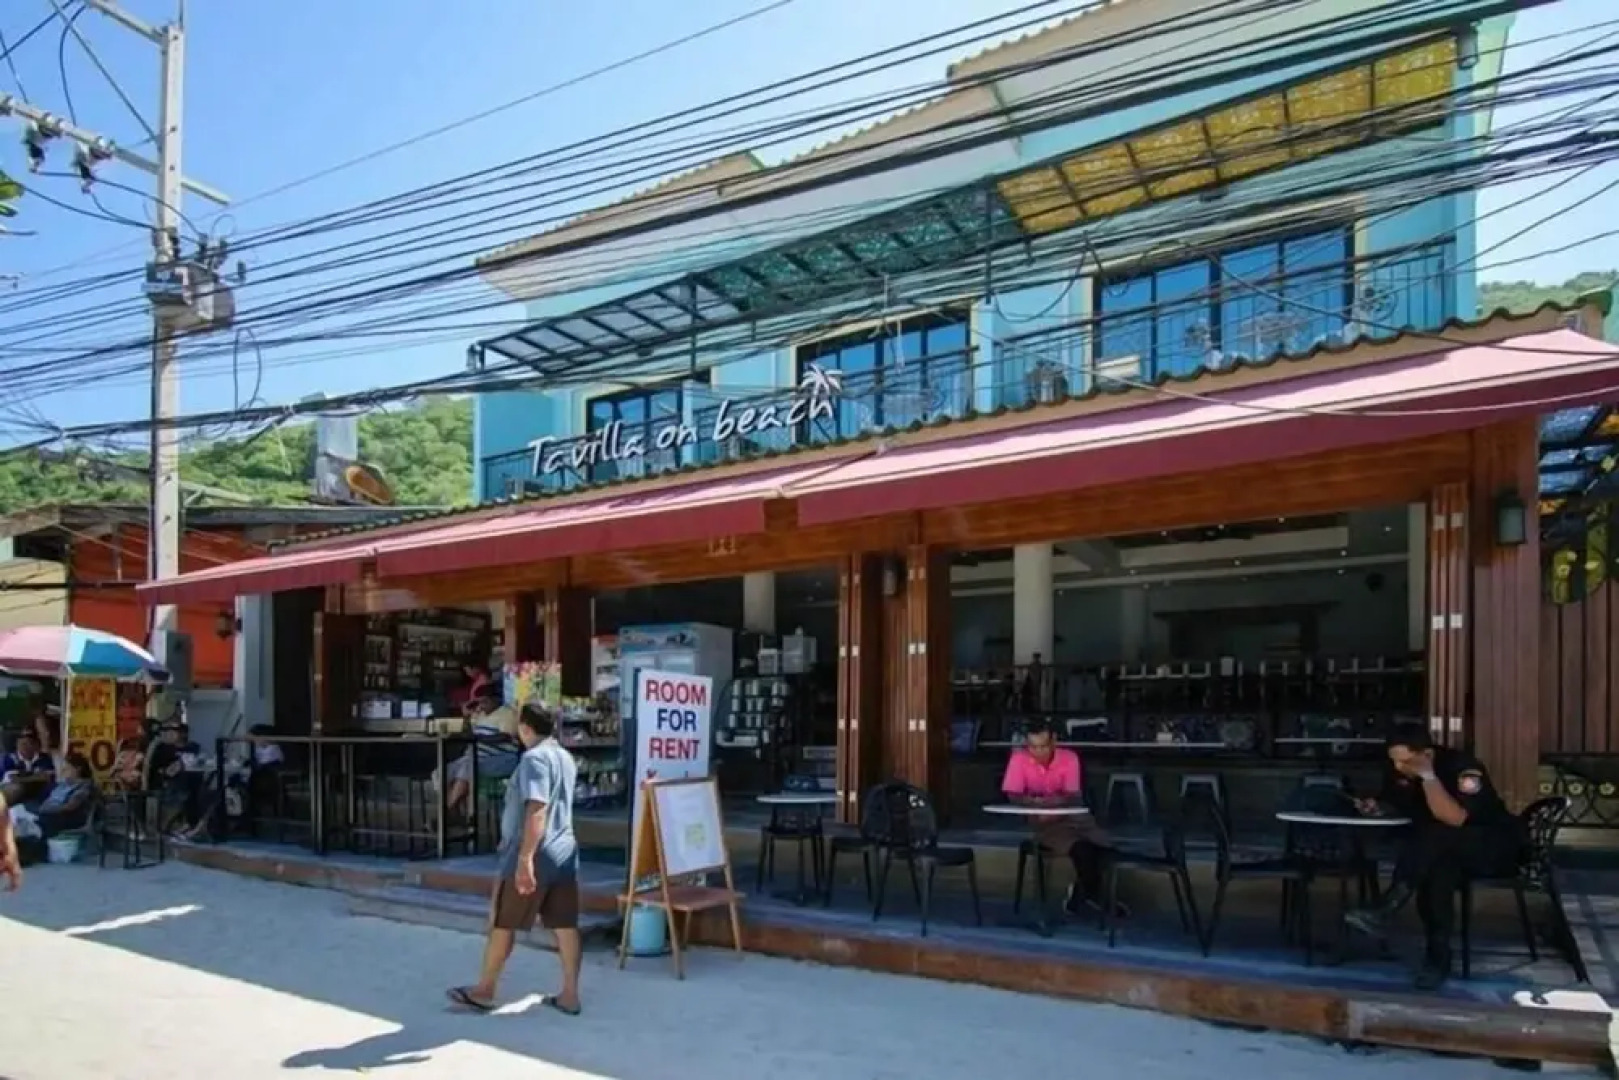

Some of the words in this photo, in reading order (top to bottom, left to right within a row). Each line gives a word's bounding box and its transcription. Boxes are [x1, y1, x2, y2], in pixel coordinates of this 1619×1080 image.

[528, 420, 646, 477] Tavilla
[656, 422, 698, 447] on
[713, 396, 836, 442] beach
[645, 679, 707, 706] ROOM
[656, 708, 697, 732] FOR
[648, 737, 700, 761] RENT
